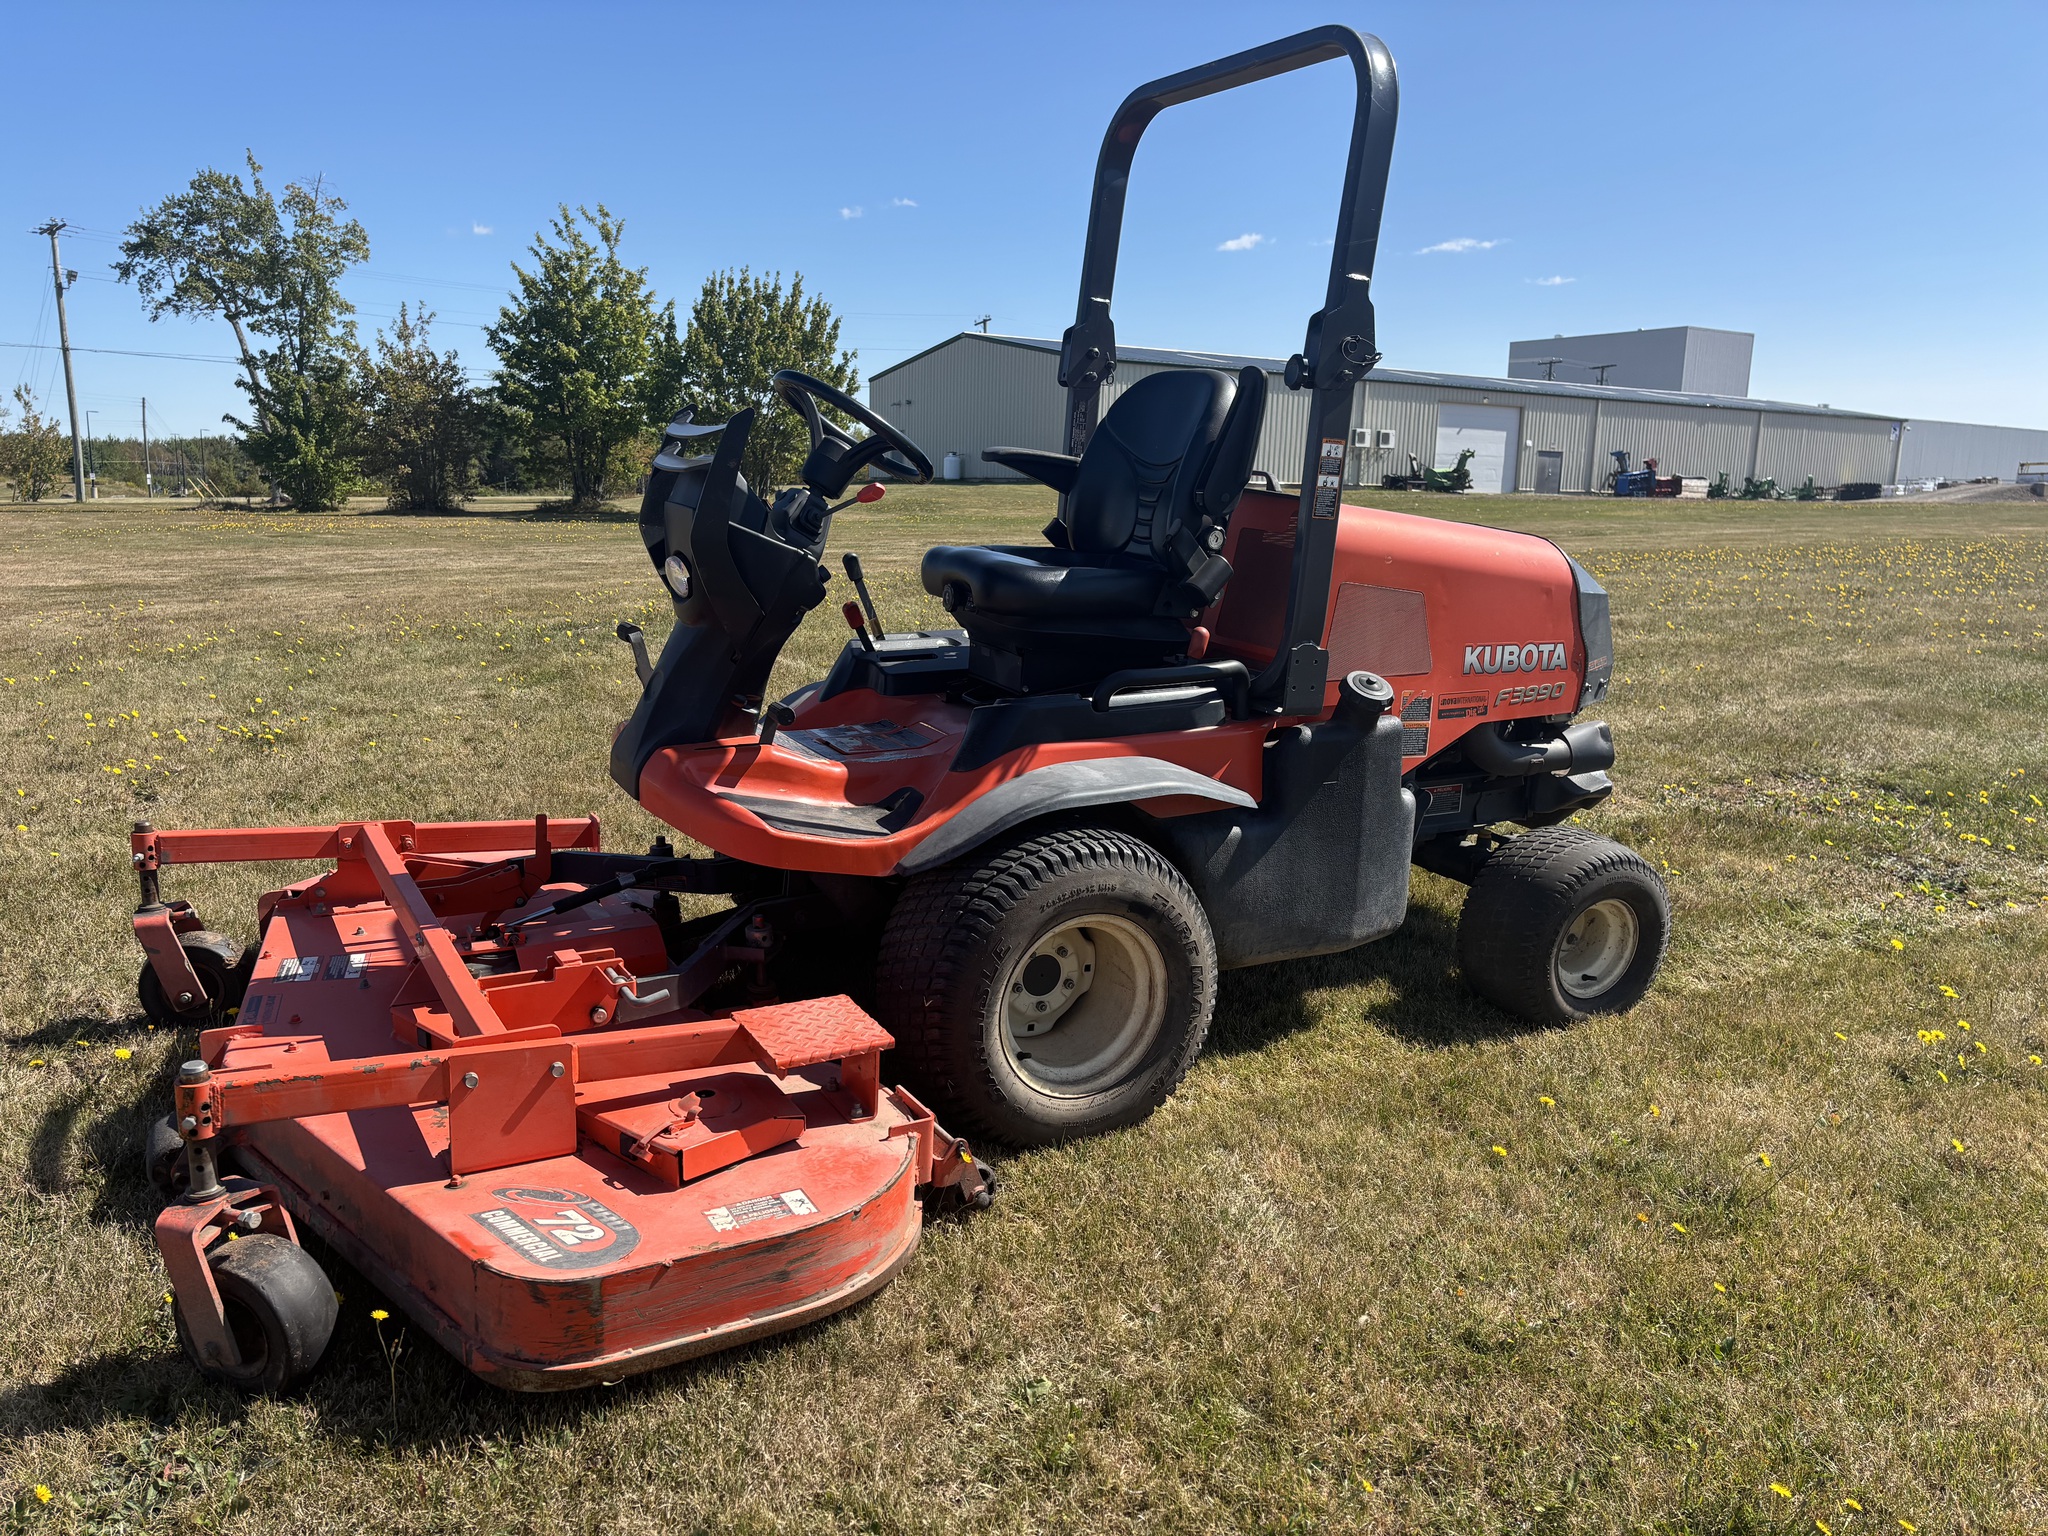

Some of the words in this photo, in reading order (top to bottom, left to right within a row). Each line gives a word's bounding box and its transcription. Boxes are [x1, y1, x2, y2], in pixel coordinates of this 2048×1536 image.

[1463, 642, 1567, 675] KUBOTA
[1493, 682, 1566, 707] F3990
[1152, 893, 1199, 956] TURF
[970, 938, 1012, 1102] CARLISLE
[741, 1195, 773, 1206] DANGER
[748, 1207, 781, 1218] PELIGRO
[481, 1210, 563, 1262] COMMERCIAL
[532, 1209, 605, 1246] 72
